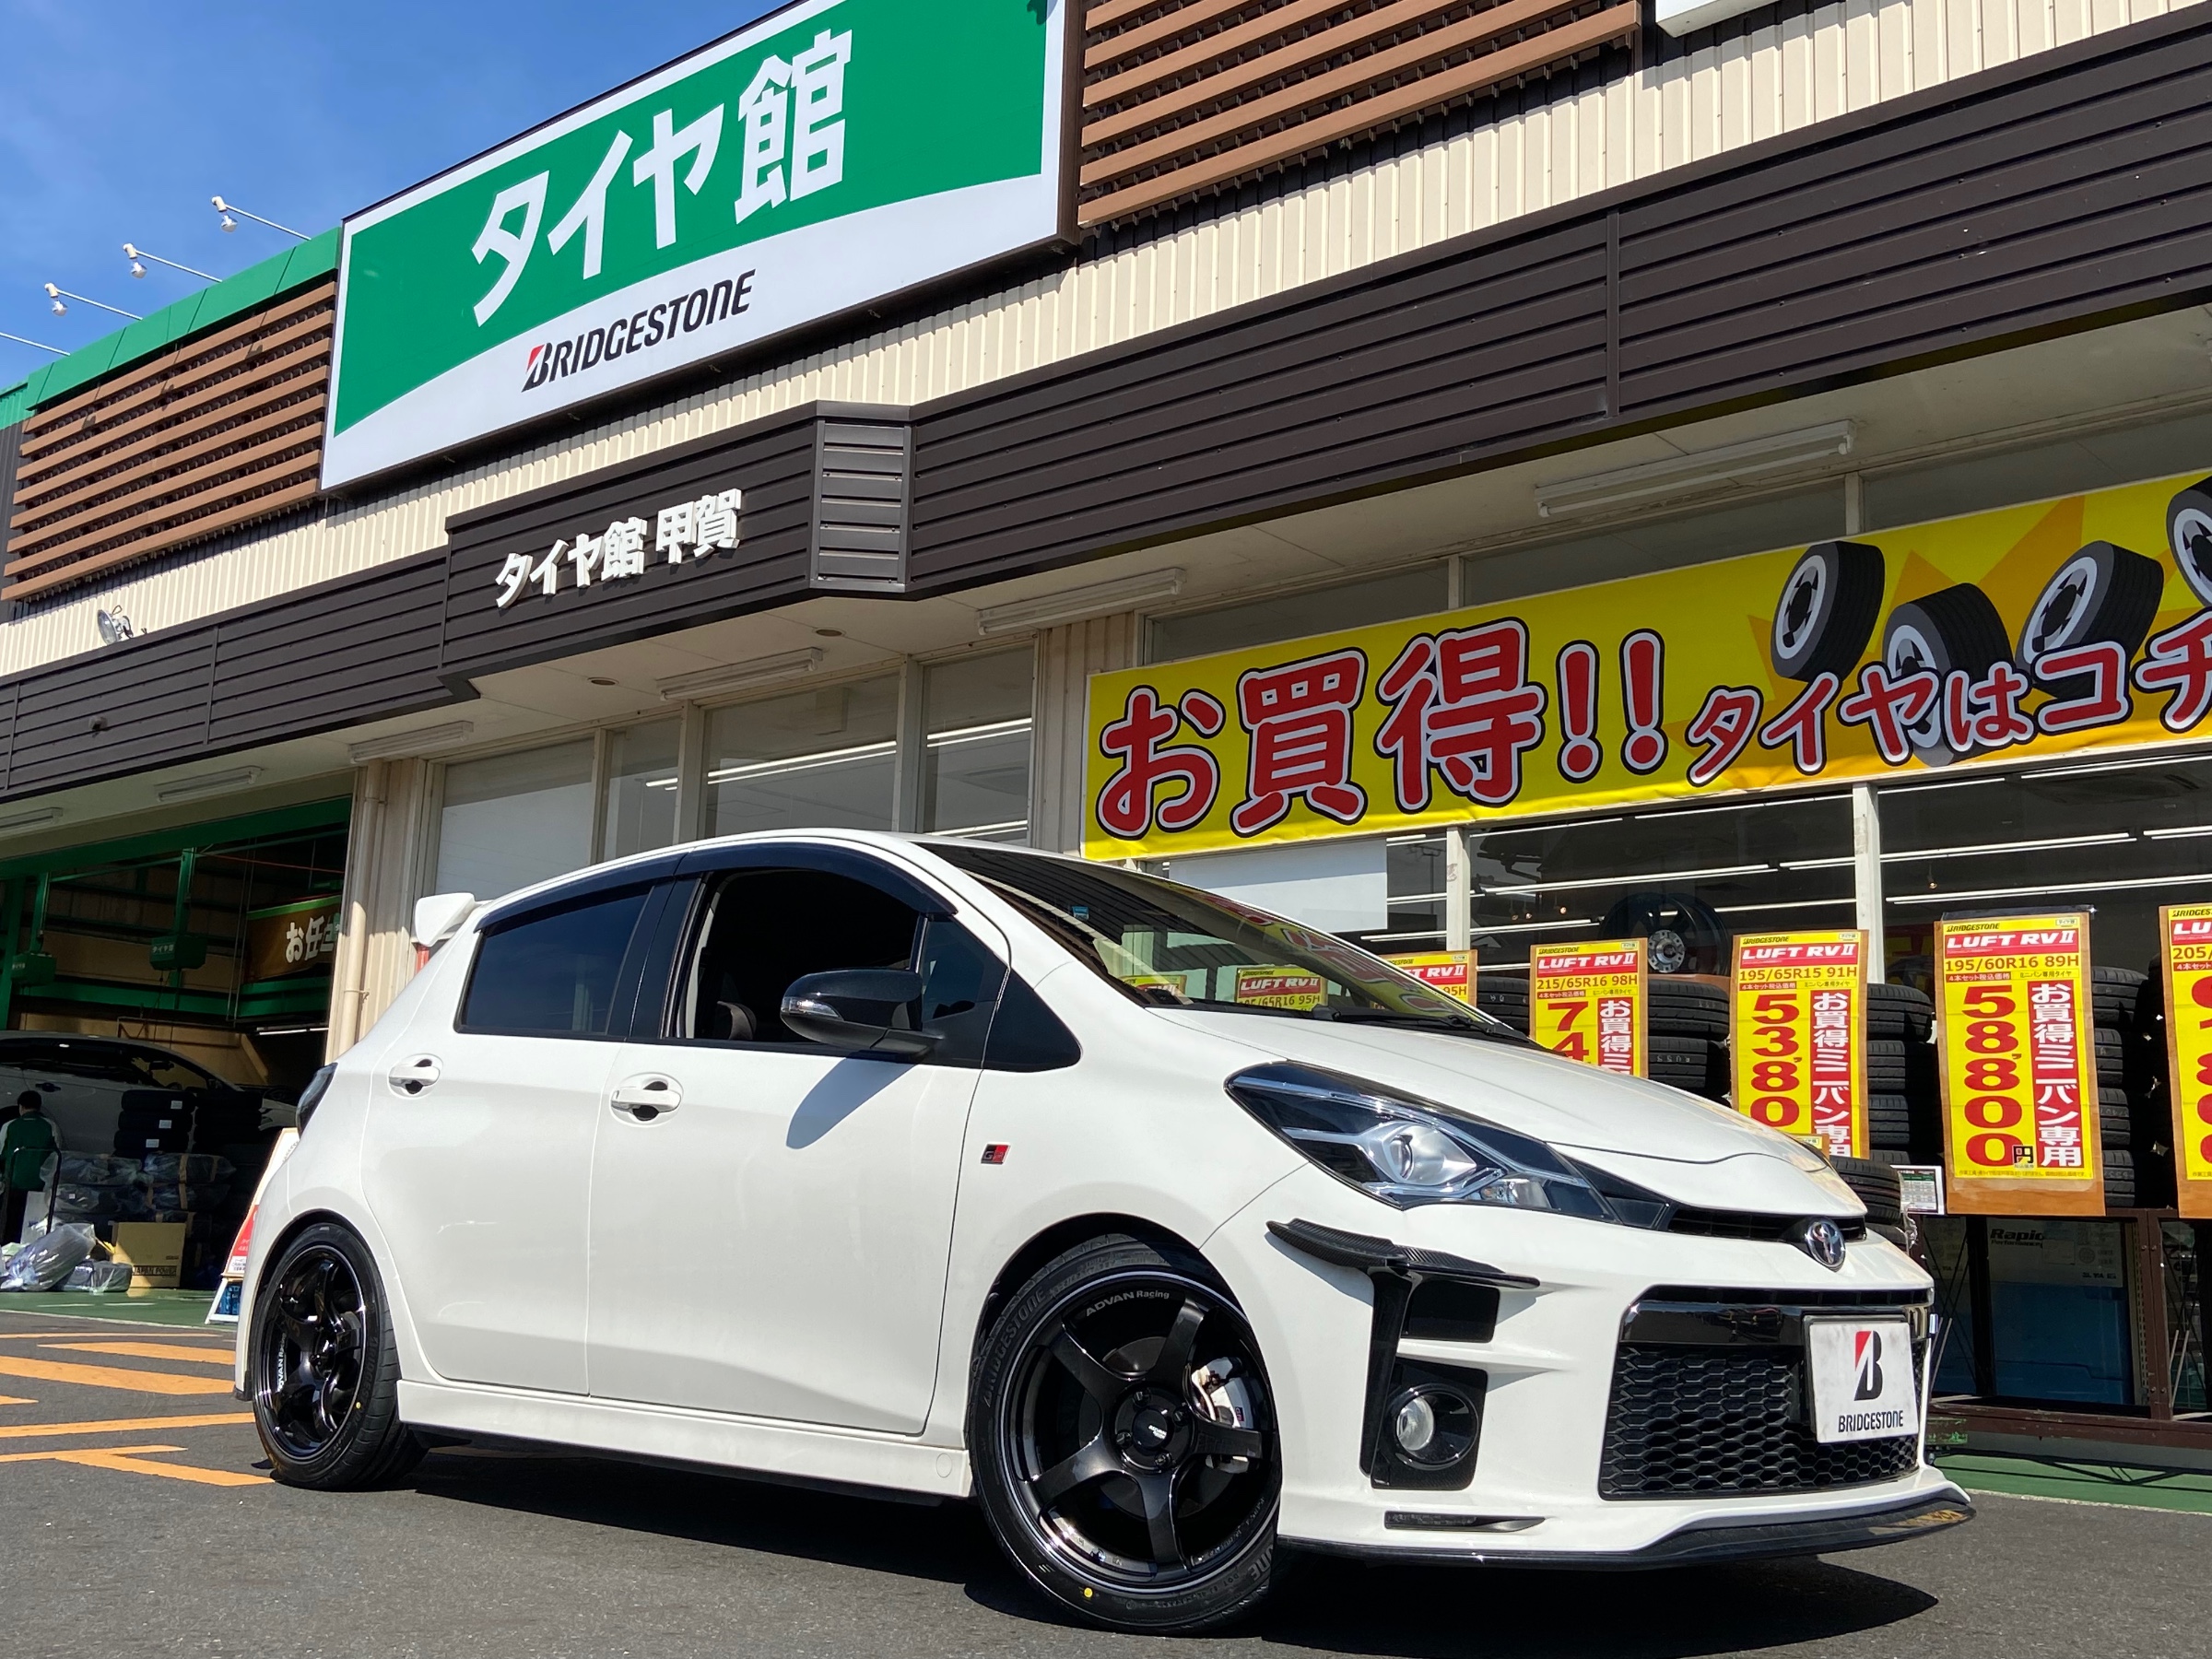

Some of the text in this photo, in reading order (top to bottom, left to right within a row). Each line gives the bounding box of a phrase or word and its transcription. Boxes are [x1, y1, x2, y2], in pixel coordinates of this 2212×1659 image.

[471, 29, 853, 327] タイヤ館
[521, 268, 756, 393] BRIDGESTONE
[495, 488, 742, 608] タイヤ館 甲賀
[2172, 909, 2212, 918] BRIDGES
[1947, 923, 2000, 932] BRIDGESTONE
[1743, 936, 1789, 945] BRIDGESTONE
[1947, 935, 2016, 949] LUFT
[1538, 947, 1580, 955] BRIDGESTONE
[1743, 947, 1803, 959] LUFT
[1538, 957, 1592, 970] LUFT
[1946, 955, 2079, 972] 195/60R16 89H
[1740, 966, 1857, 982] 195/65R15 91H
[1241, 978, 1283, 990] LUFT
[1536, 974, 1637, 991] 215/65R16 98H
[1299, 995, 1320, 1005] 95H
[2031, 982, 2083, 1168] お買得ミニバン専用
[1085, 1290, 1171, 1317] ADVAN Racing
[1838, 1409, 1904, 1433] BRIDGESTONE
